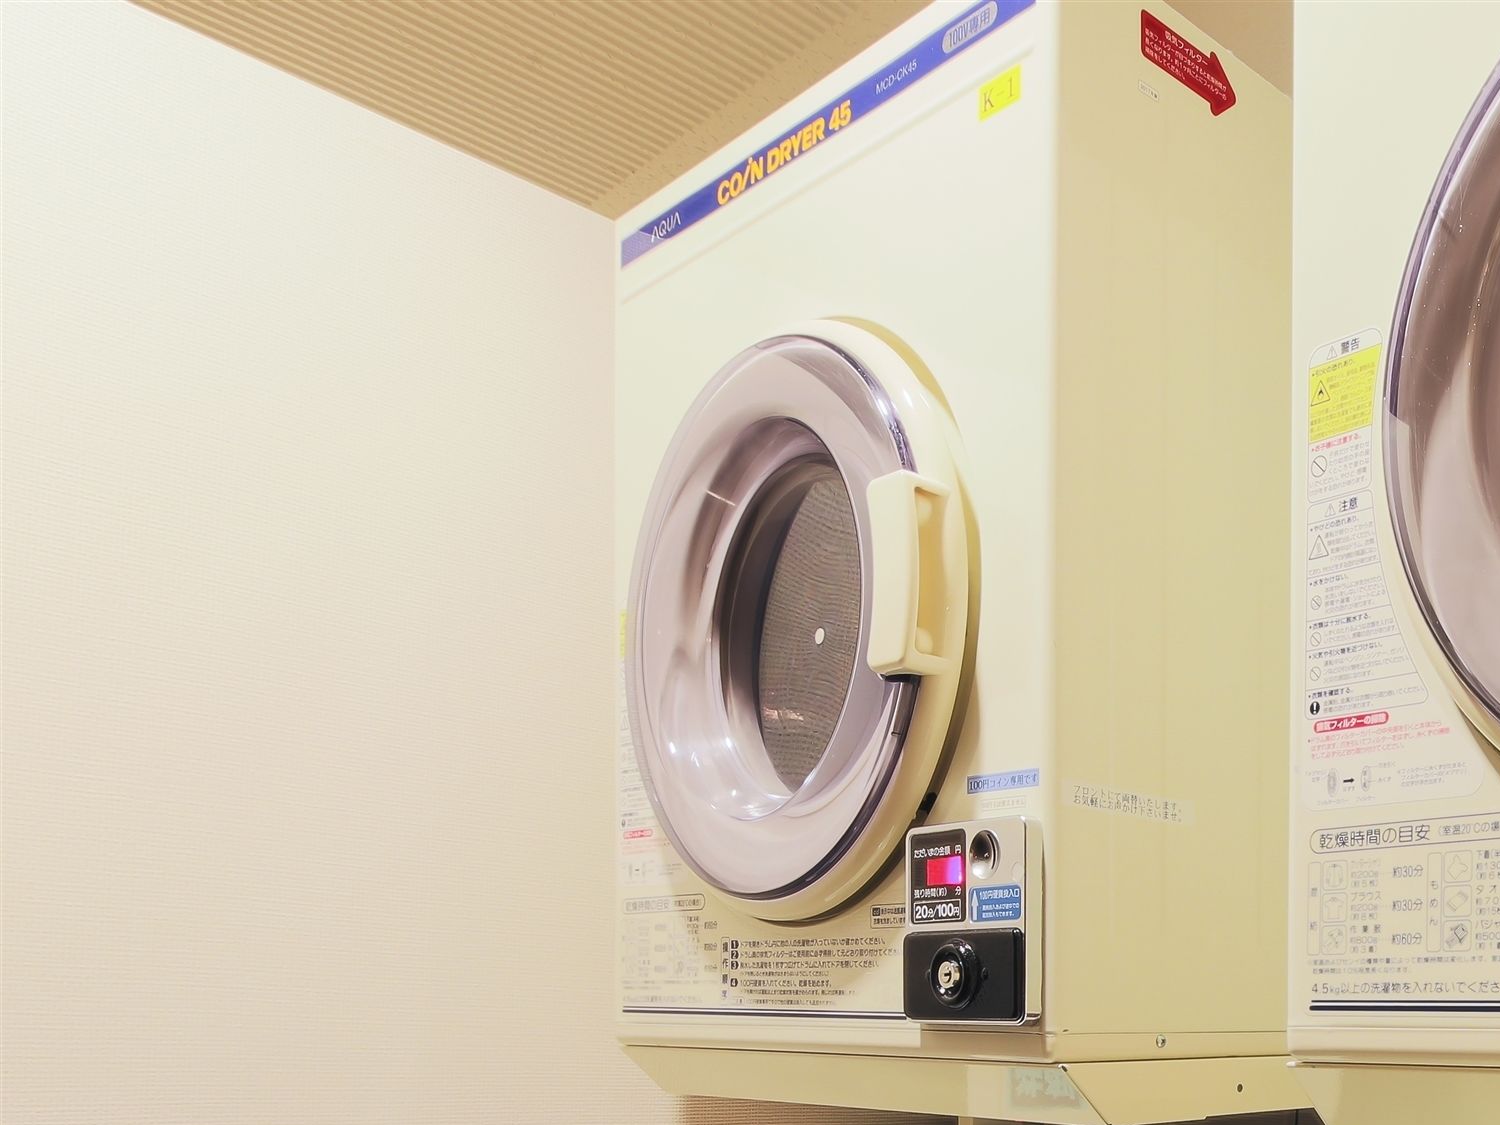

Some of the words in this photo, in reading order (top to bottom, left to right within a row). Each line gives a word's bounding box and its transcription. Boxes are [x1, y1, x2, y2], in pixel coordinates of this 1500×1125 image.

[874, 58, 918, 95] MCD-CK45
[983, 76, 1014, 112] K-1
[766, 117, 825, 175] DRYER
[828, 99, 852, 132] 45
[650, 212, 681, 243] AQUA
[1338, 496, 1358, 512] 注意
[969, 772, 1038, 792] 100円コイン専用です
[954, 844, 963, 855] 円
[1319, 824, 1431, 850] 乾燥時間の目安
[914, 902, 961, 921] 20分/100円
